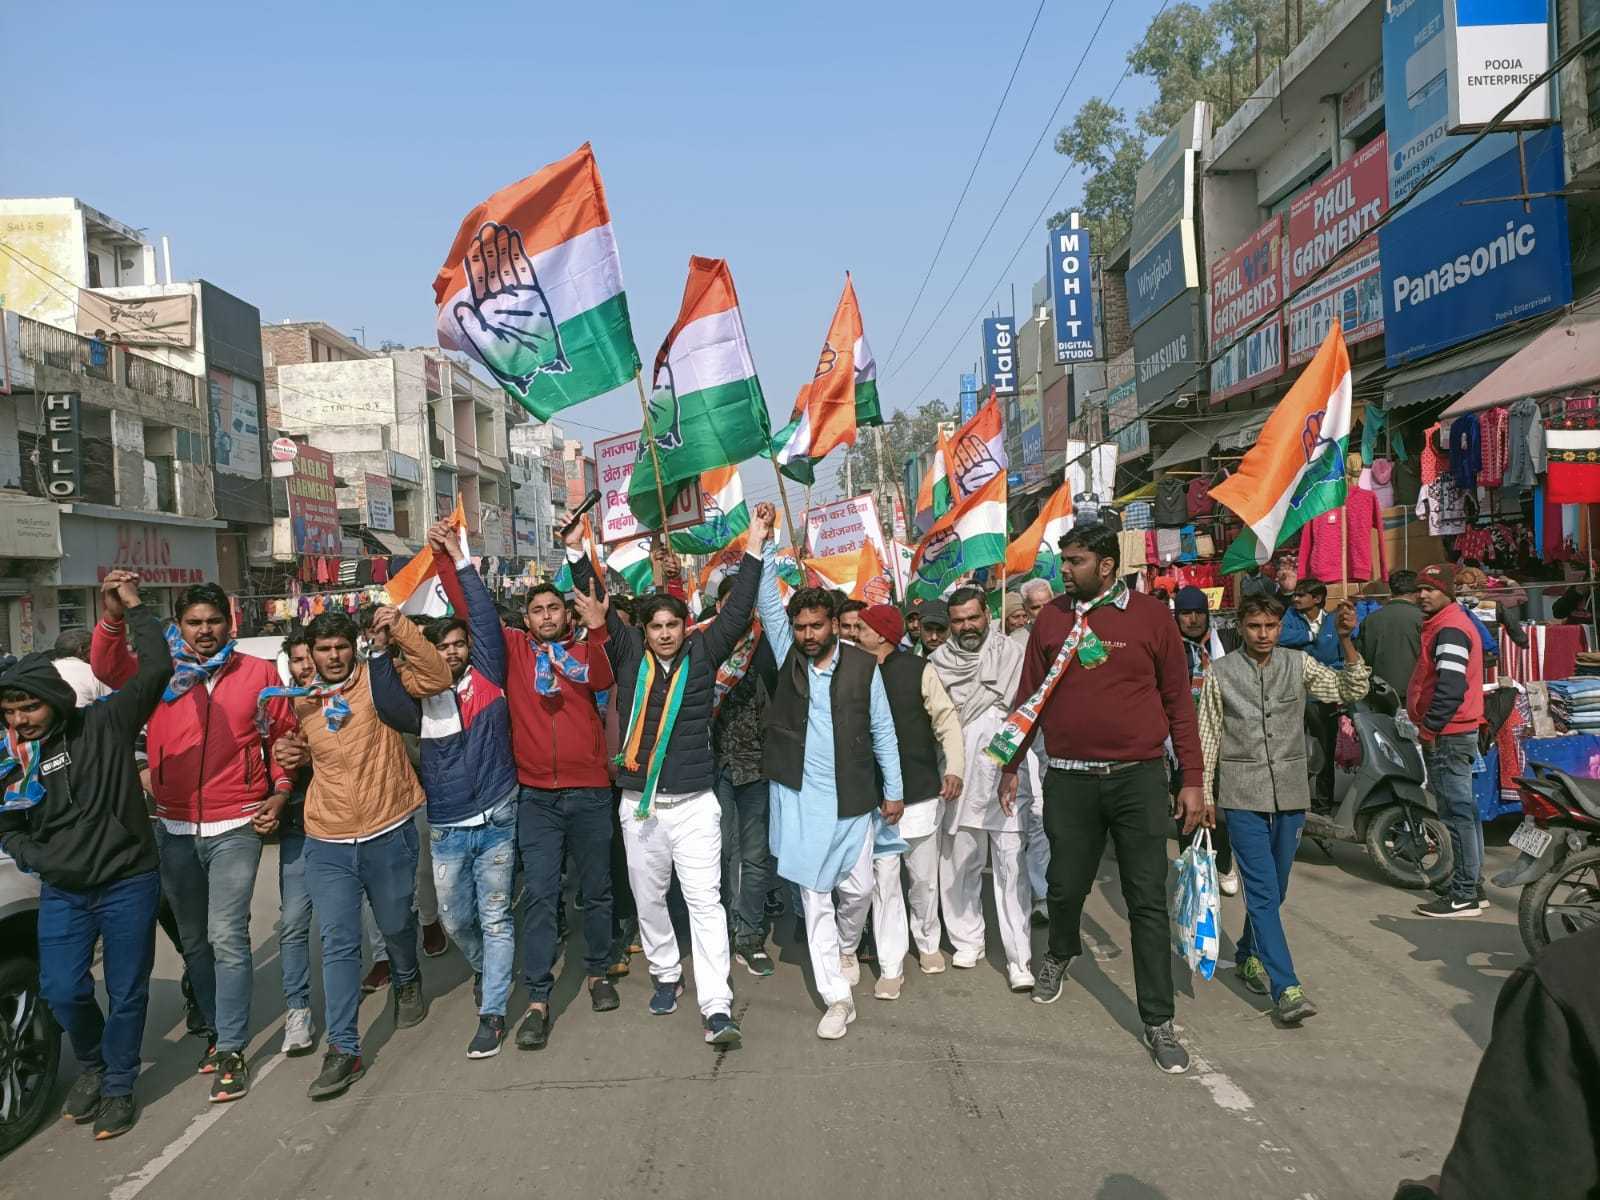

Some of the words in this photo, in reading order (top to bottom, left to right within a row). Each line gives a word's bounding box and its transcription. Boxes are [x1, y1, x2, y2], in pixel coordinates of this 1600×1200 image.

[1485, 59, 1523, 70] POOJA
[1314, 175, 1356, 230] PAUL
[1293, 197, 1381, 277] GARMENTS
[1060, 234, 1082, 338] MOHIT
[1137, 248, 1173, 302] Whirlpool
[1214, 266, 1242, 306] PAUL
[1393, 220, 1536, 313] Panasonic
[1215, 273, 1277, 335] GARMENTS
[992, 323, 1013, 393] Haier
[1058, 341, 1092, 350] DIGITAL
[1059, 350, 1094, 360] STUDIO
[1141, 334, 1187, 383] SAMSUNG
[47, 394, 74, 496] HELLO
[293, 455, 328, 480] SAGAR
[602, 441, 637, 458] भाजपा
[289, 479, 336, 501] GARMENTS
[114, 526, 171, 566] Hello
